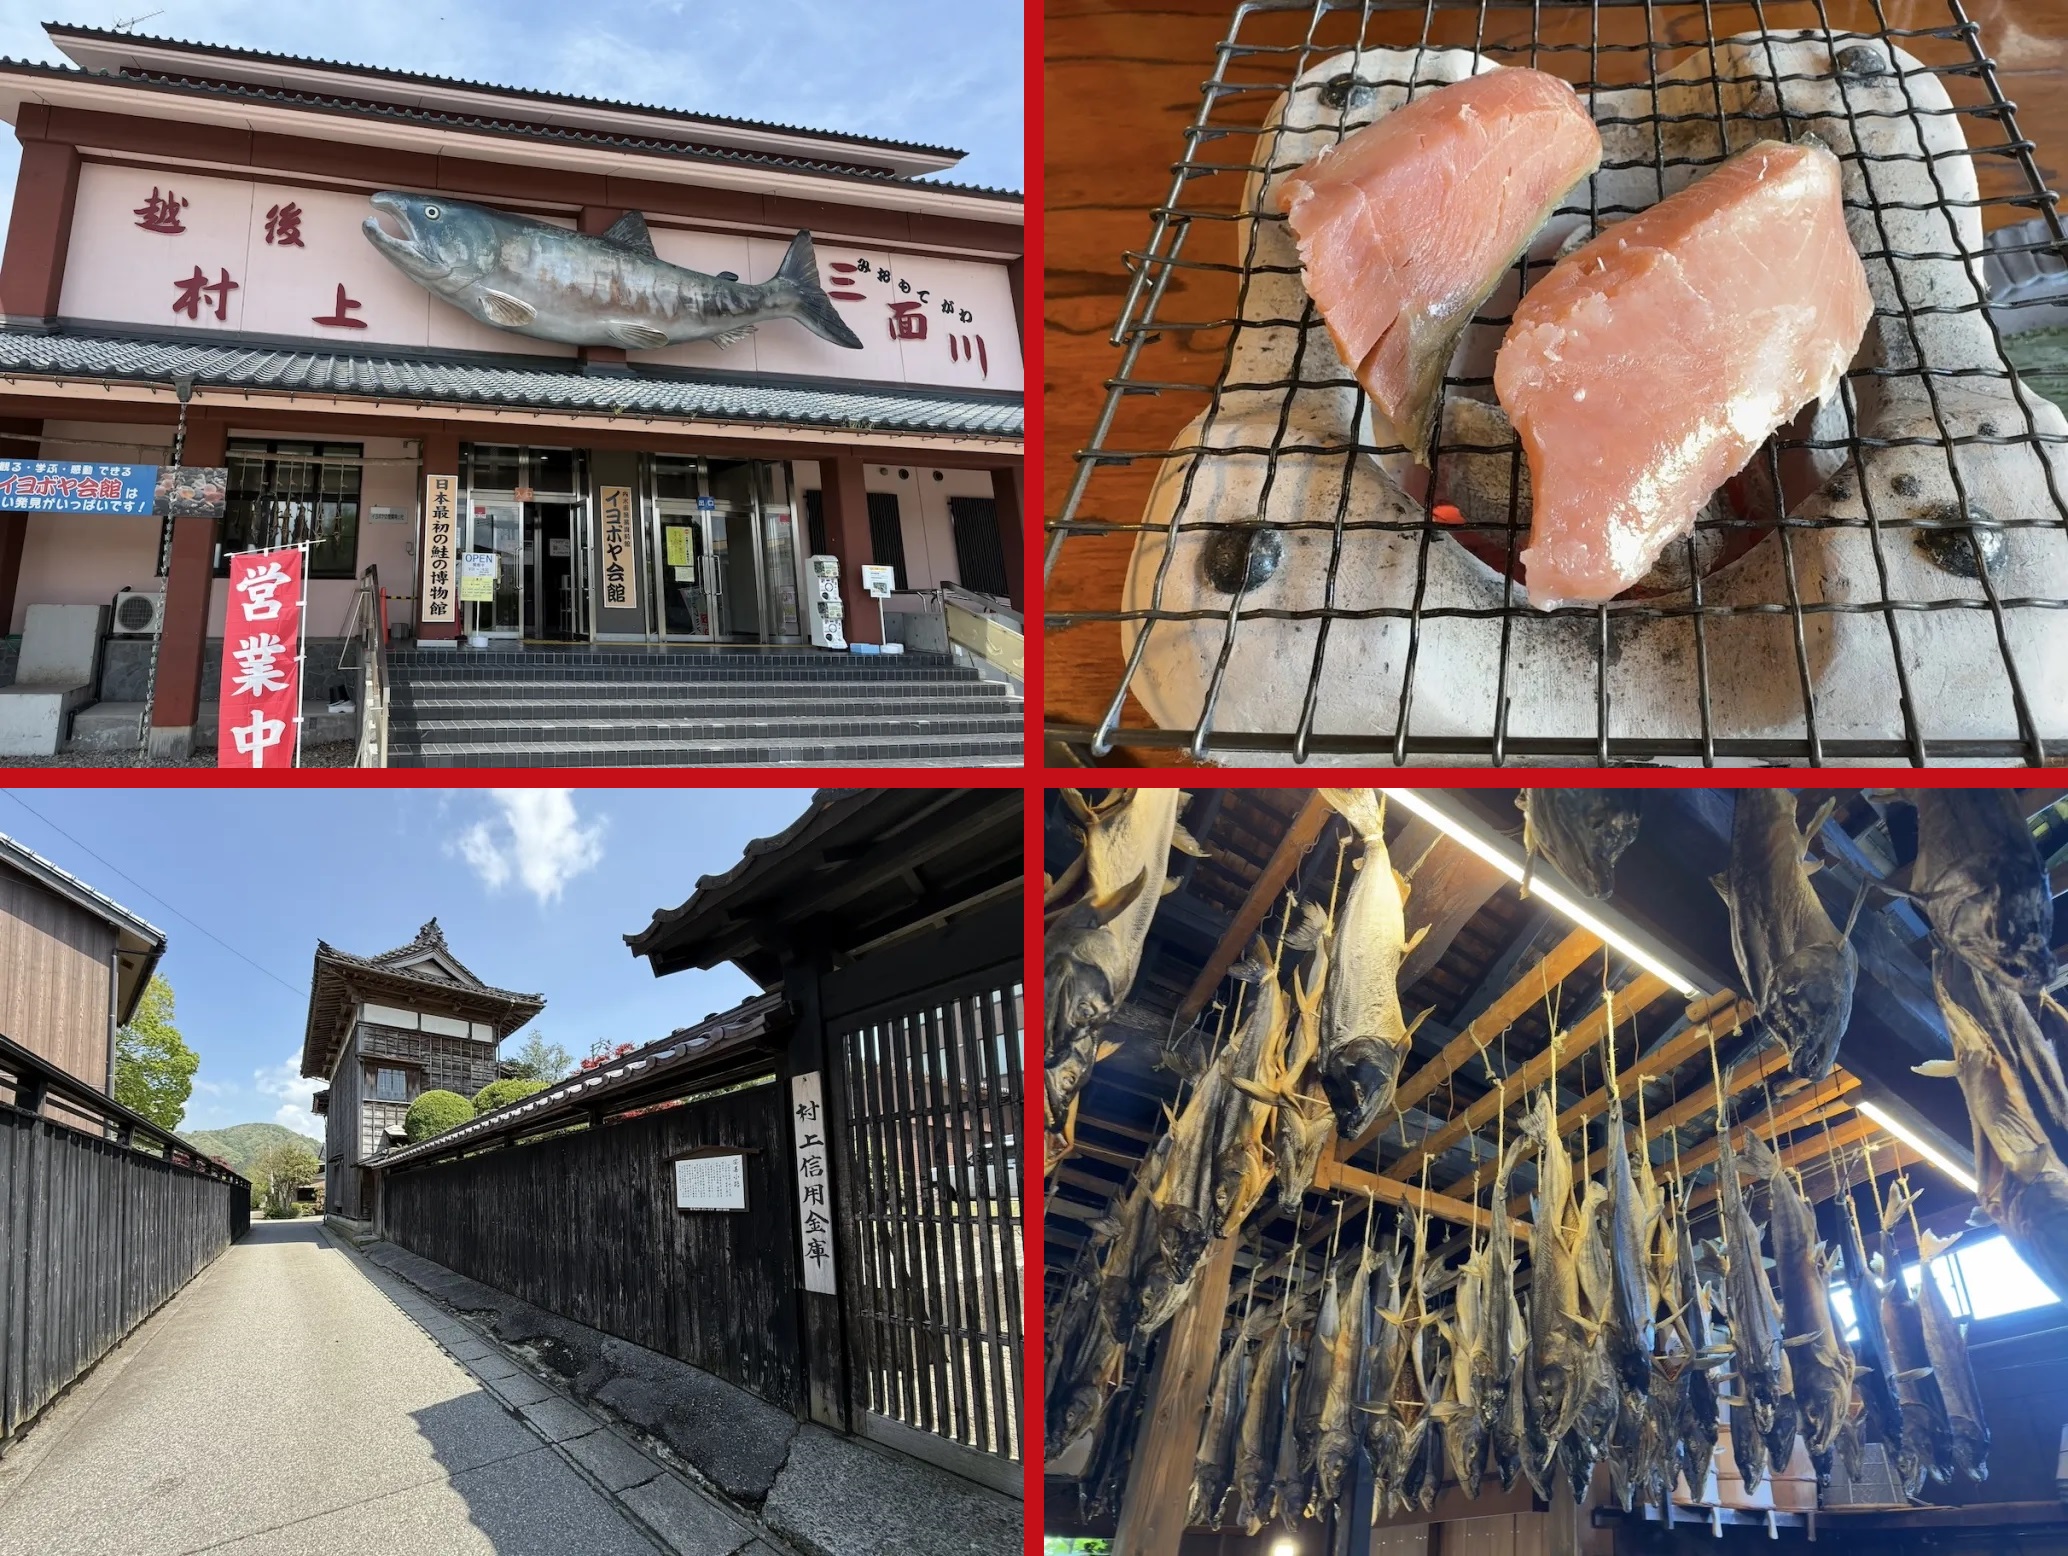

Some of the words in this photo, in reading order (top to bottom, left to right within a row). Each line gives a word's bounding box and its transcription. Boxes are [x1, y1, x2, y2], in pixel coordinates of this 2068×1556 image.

[133, 186, 305, 248] 越後
[172, 265, 368, 330] 村上
[828, 262, 988, 381] 三面川
[857, 258, 973, 323] みおもてがわ
[0, 474, 122, 499] イヨボヤ会館
[126, 488, 138, 499] は
[99, 466, 131, 476] できる
[430, 479, 450, 616] 日本最初の鮭の博物館
[465, 554, 493, 563] OPEN
[605, 490, 626, 602] イヨボヤ会館
[231, 562, 292, 767] 営業中
[796, 1100, 829, 1269] 村上信用金庫
